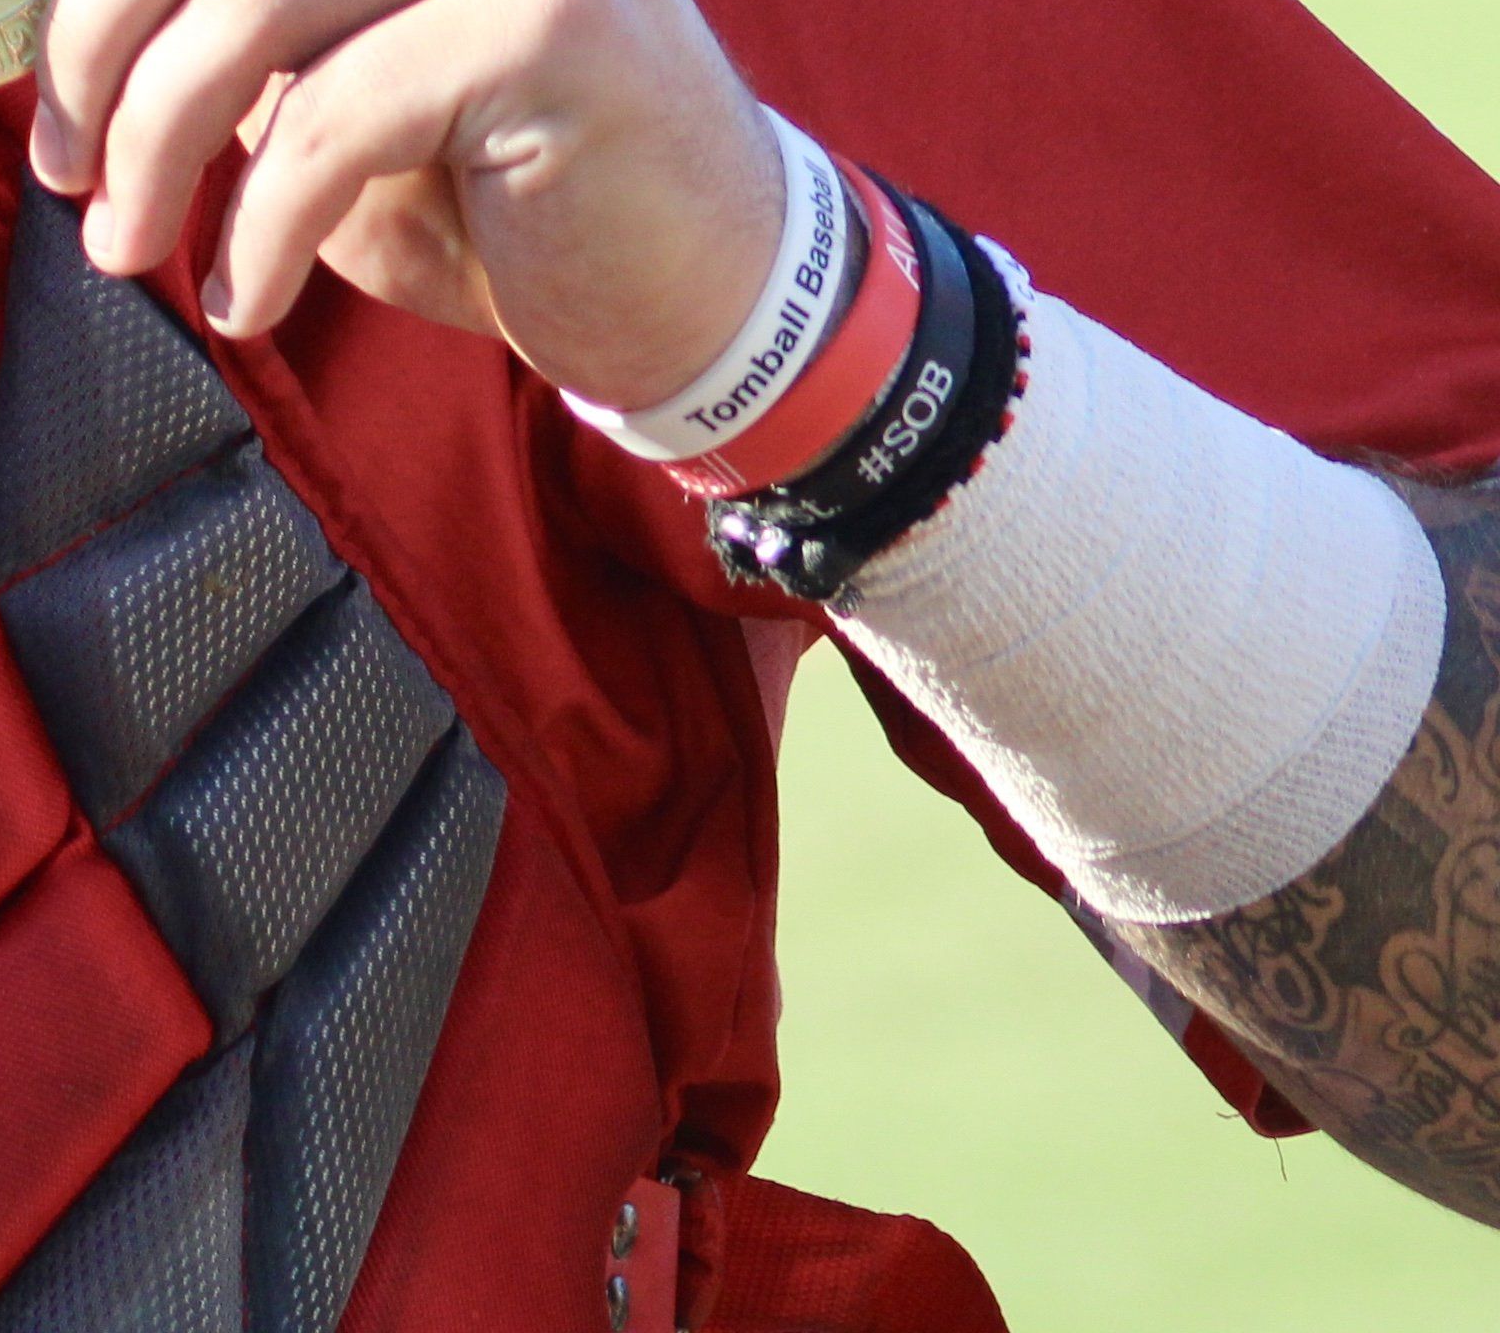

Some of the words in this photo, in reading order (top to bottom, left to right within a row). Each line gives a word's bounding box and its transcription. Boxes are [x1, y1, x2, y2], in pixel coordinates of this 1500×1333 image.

[685, 298, 812, 433] Tomball
[795, 155, 837, 297] Baseball
[857, 359, 954, 485] #SOB
